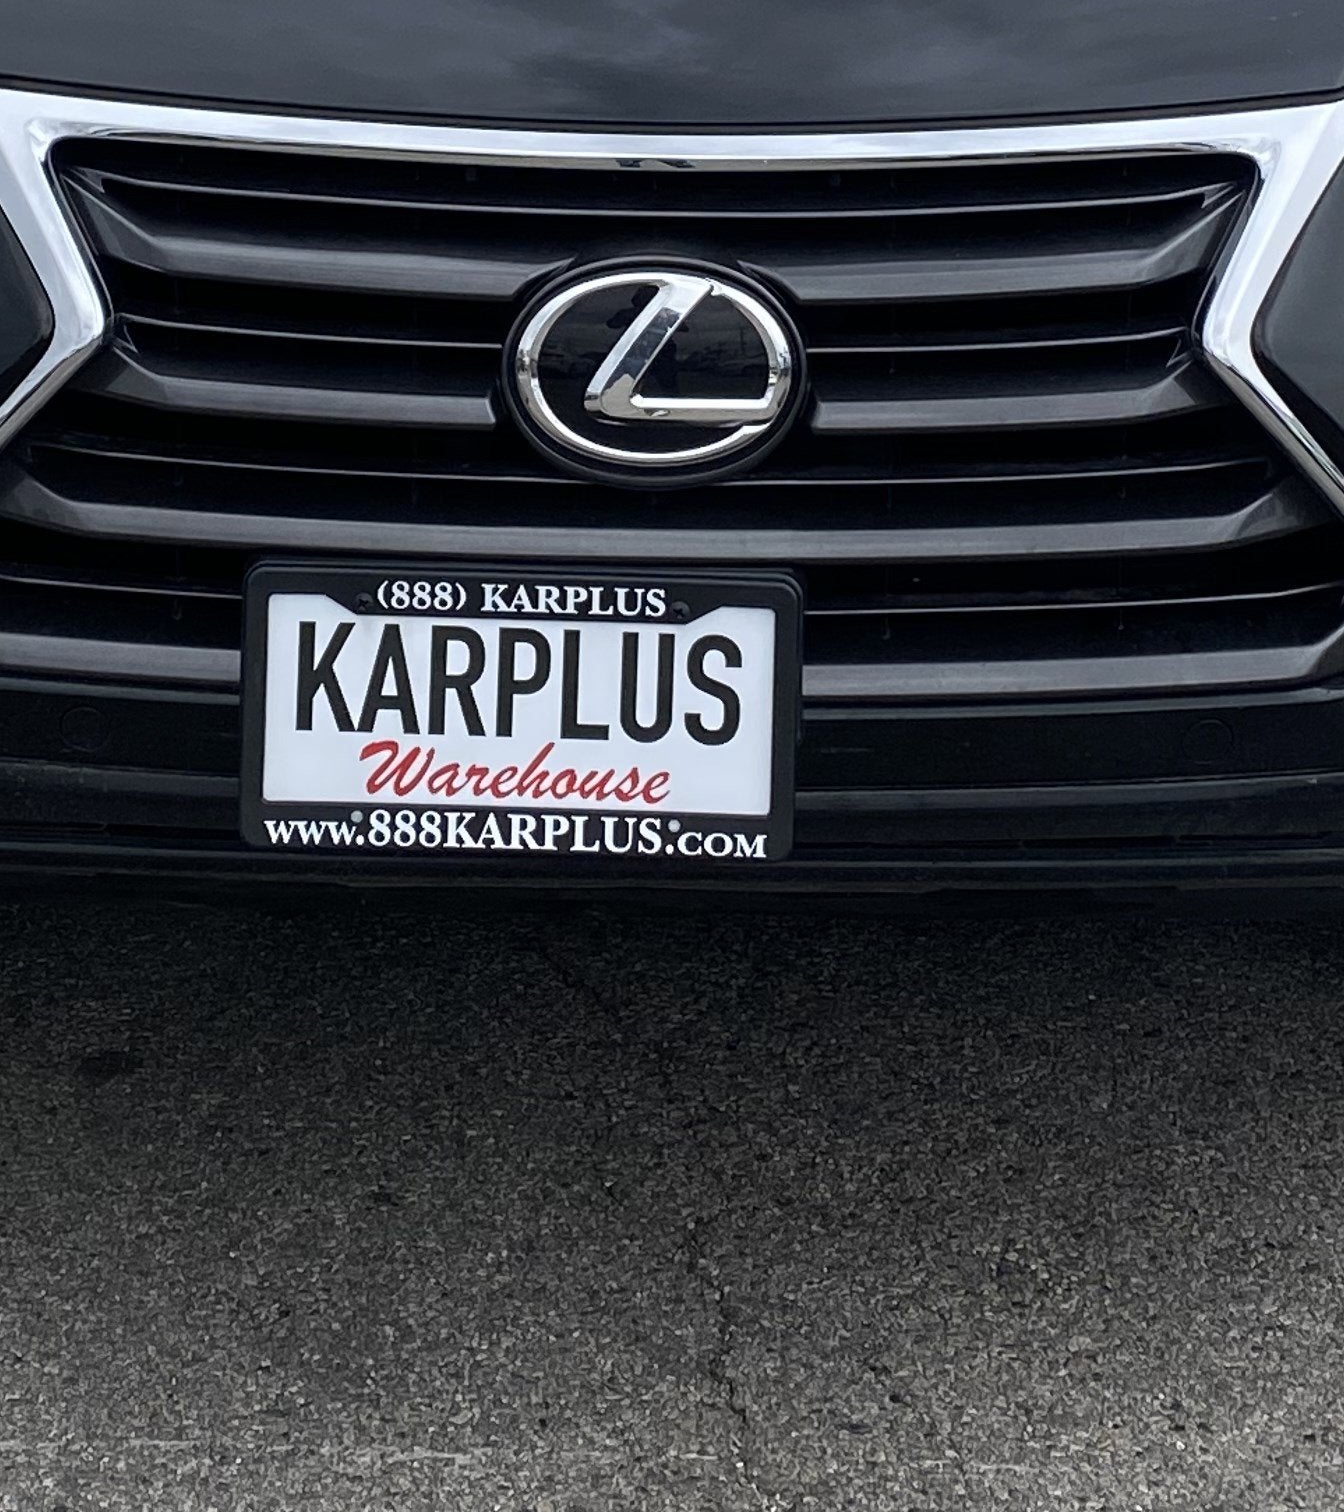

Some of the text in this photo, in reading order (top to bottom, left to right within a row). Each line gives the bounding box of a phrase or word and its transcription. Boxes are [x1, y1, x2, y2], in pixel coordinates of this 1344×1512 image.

[376, 579, 667, 618] (888) KARPLUS
[295, 620, 743, 746] KARPLUS
[358, 739, 671, 805] Warehouse
